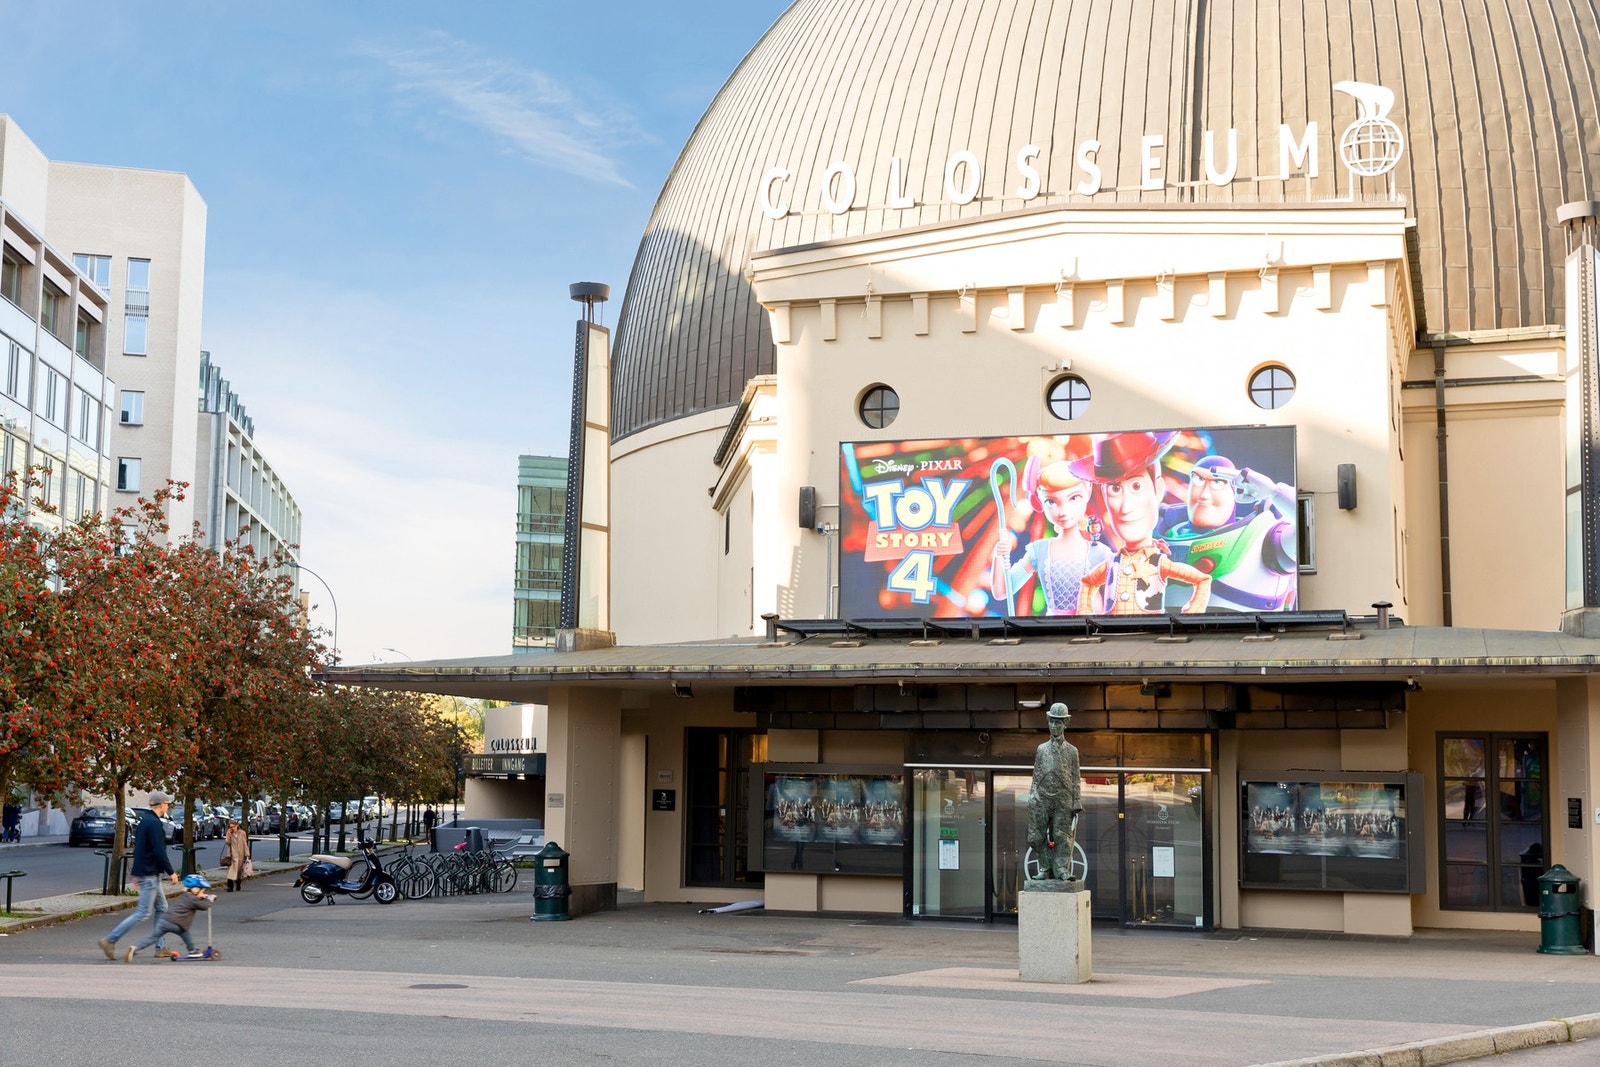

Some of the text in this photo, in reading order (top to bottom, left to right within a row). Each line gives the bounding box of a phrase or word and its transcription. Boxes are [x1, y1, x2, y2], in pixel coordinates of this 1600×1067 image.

[761, 121, 1318, 220] COLOSSEUM
[920, 460, 963, 471] PIXAR
[875, 532, 954, 548] STORY
[887, 549, 938, 604] 4
[491, 737, 537, 750] COLOSSEUM
[472, 758, 525, 770] BILLETTER INNGANG
